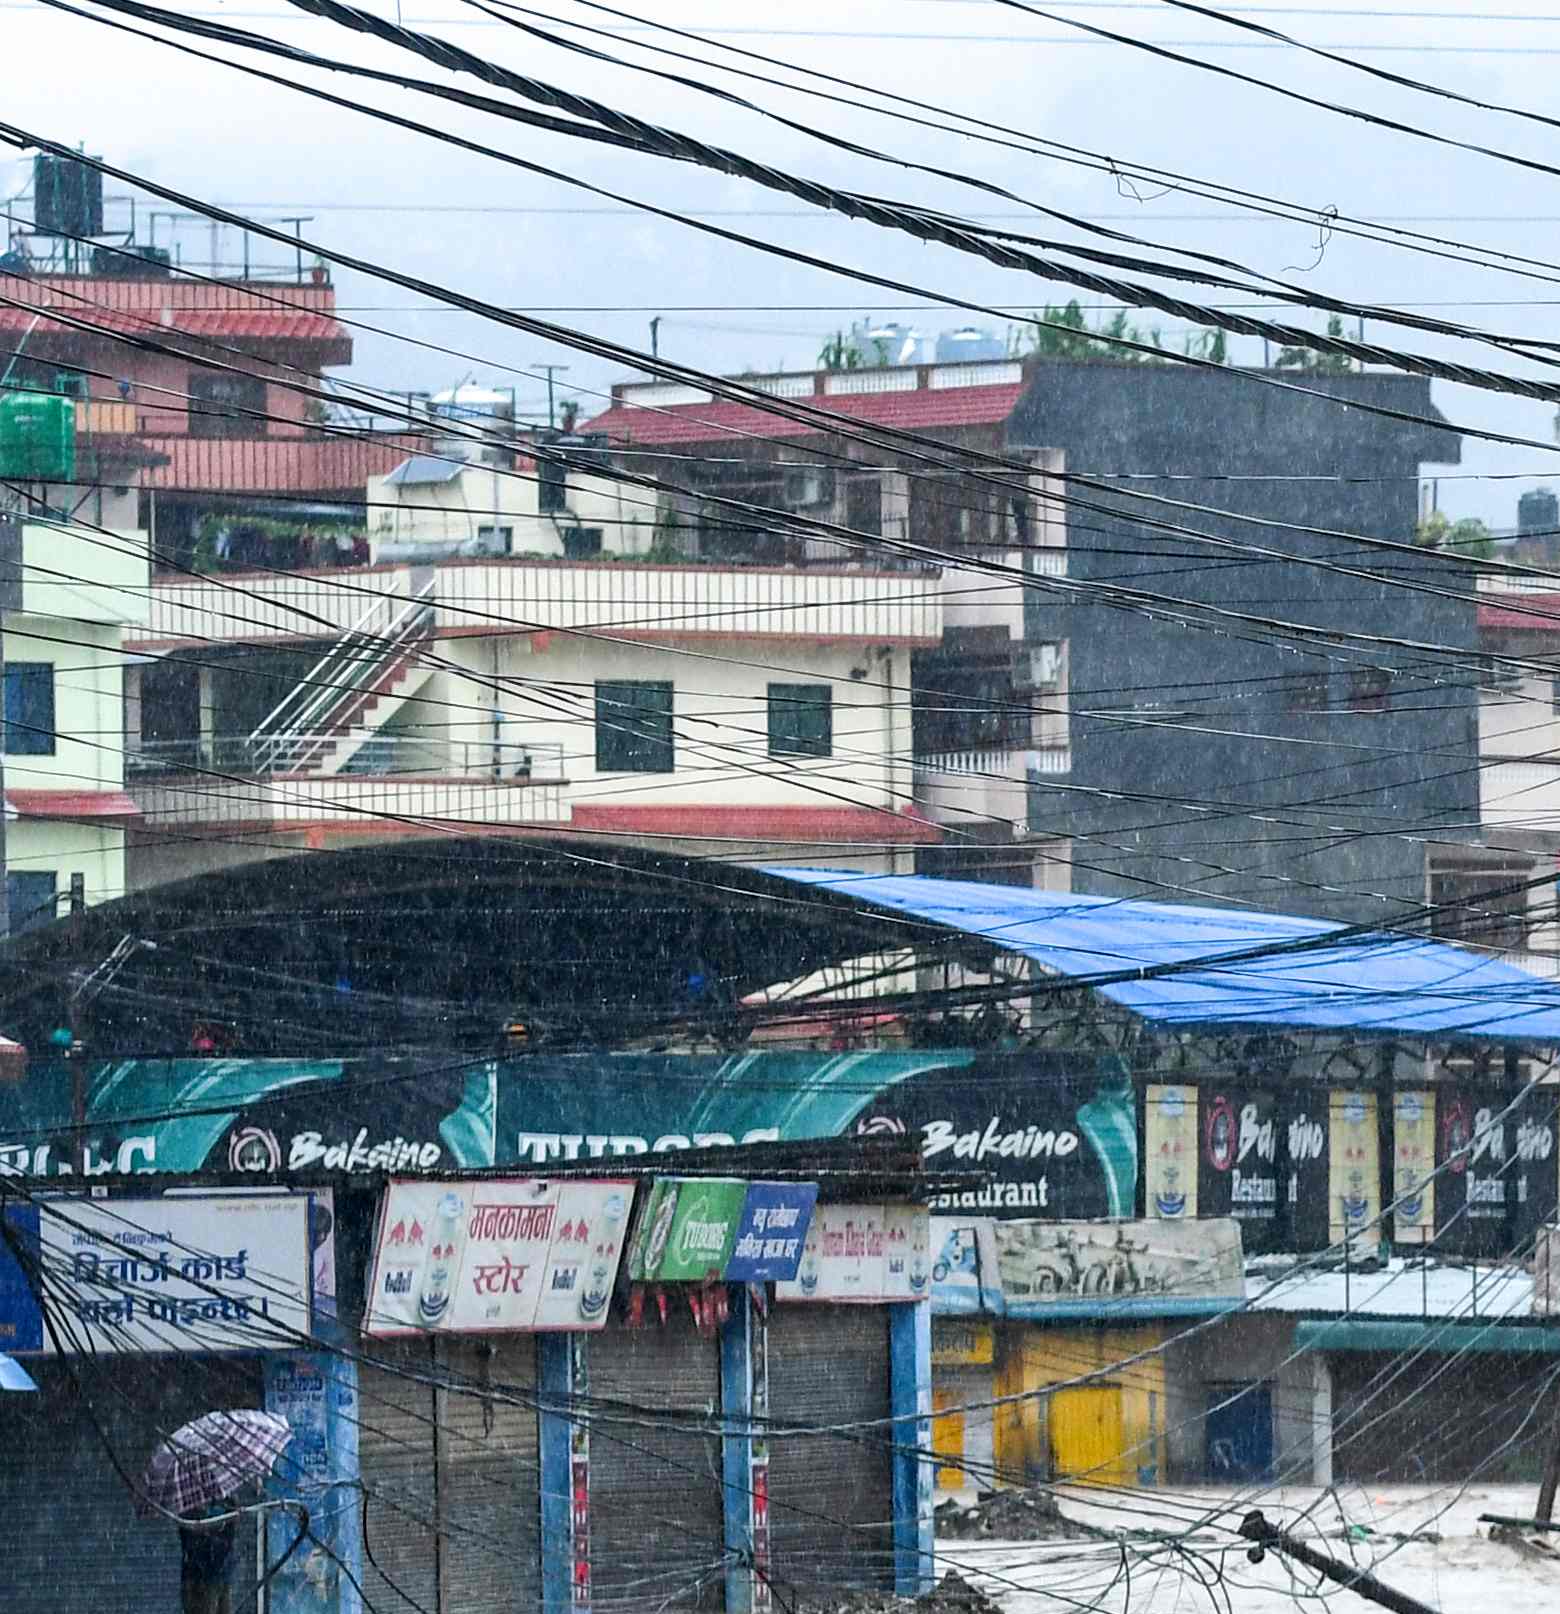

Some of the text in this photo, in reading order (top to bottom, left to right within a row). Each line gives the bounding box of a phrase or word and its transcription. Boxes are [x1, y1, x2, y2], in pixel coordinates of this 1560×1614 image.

[287, 1127, 441, 1171] Bakaino
[920, 1116, 1079, 1162] Bakaino
[470, 1204, 556, 1242] मनकामना
[683, 1220, 729, 1251] TUBORG
[181, 1249, 248, 1281] कार्ड
[473, 1255, 531, 1296] स्टोर
